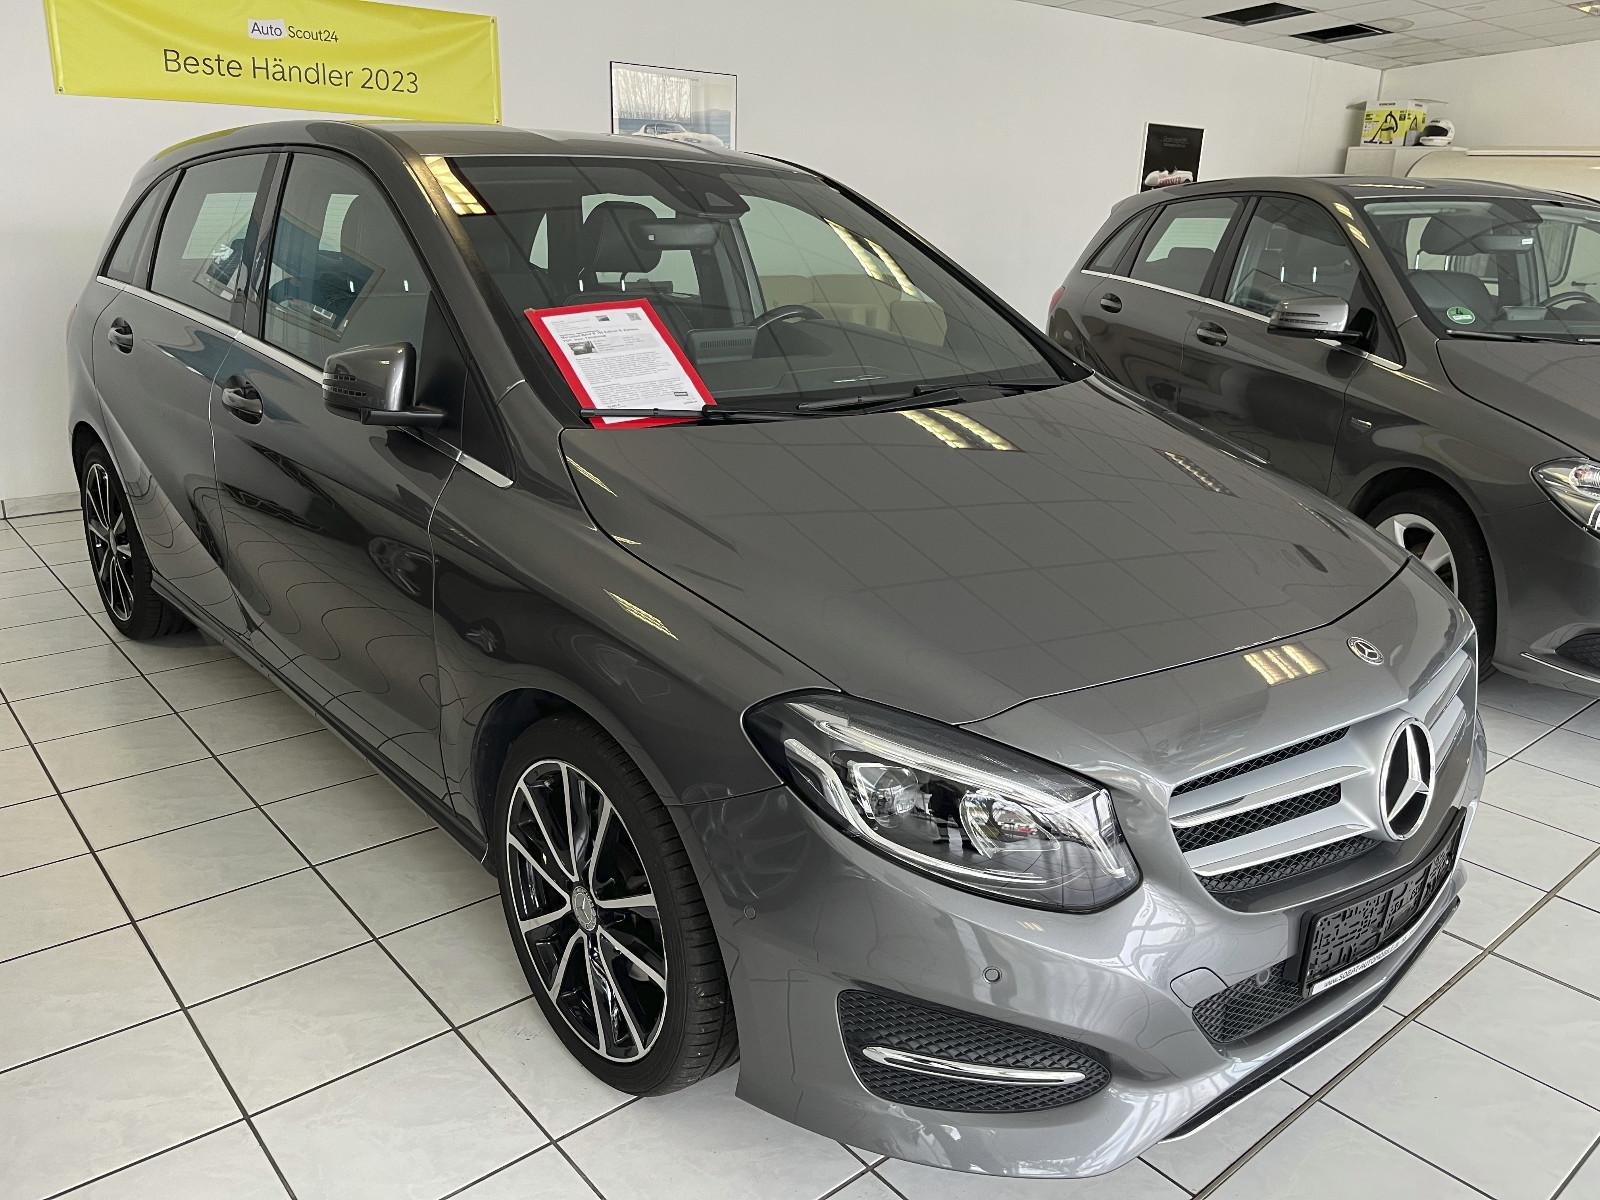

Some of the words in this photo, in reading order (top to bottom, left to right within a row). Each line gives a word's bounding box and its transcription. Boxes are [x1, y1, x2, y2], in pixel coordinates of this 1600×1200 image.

[251, 21, 283, 37] Auto
[288, 25, 339, 43] Scout24
[163, 48, 243, 77] Beste
[251, 56, 354, 88] Händler
[360, 67, 419, 94] 2023
